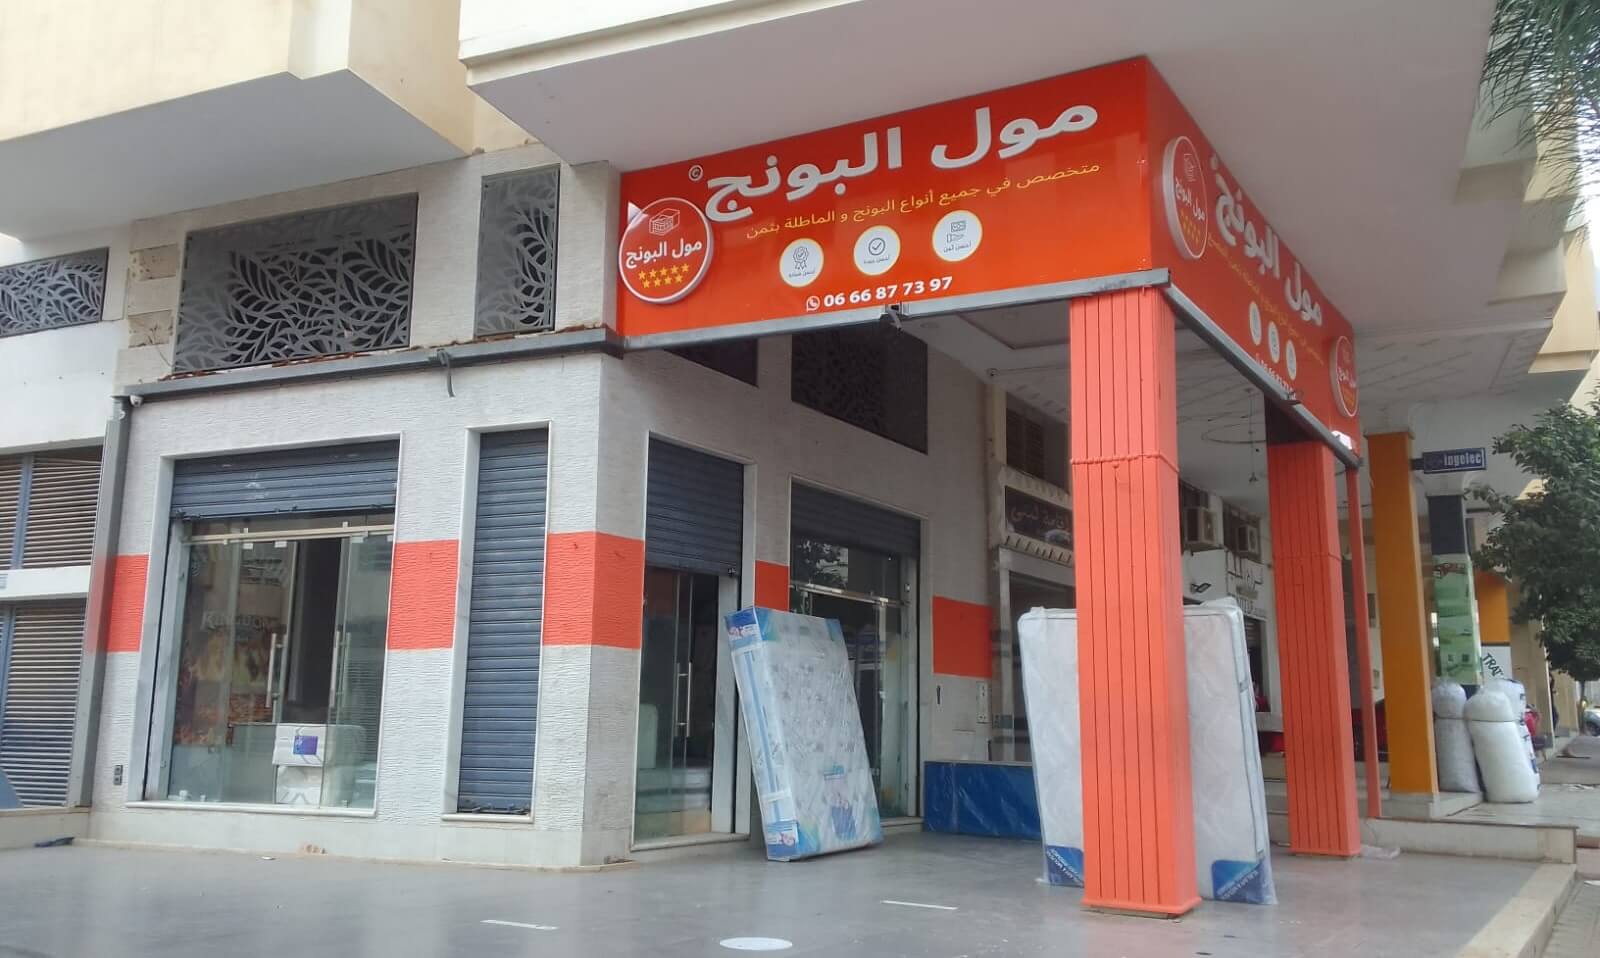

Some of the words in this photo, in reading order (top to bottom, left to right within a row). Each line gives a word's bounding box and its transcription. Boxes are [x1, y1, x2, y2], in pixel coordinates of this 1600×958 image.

[930, 104, 1099, 169] مول
[705, 126, 903, 223] البونج
[986, 176, 1011, 197] في
[1016, 163, 1100, 189] متخصص
[900, 189, 934, 213] أنواع
[939, 187, 982, 206] جميع
[839, 212, 848, 223] و
[853, 199, 895, 222] البونج
[625, 241, 668, 269] البونج
[671, 238, 703, 259] مول
[823, 292, 846, 307] 06
[849, 289, 872, 304] 66
[875, 284, 898, 300] 87
[902, 280, 925, 296] 73
[929, 276, 953, 292] 97
[1284, 260, 1322, 327] مول
